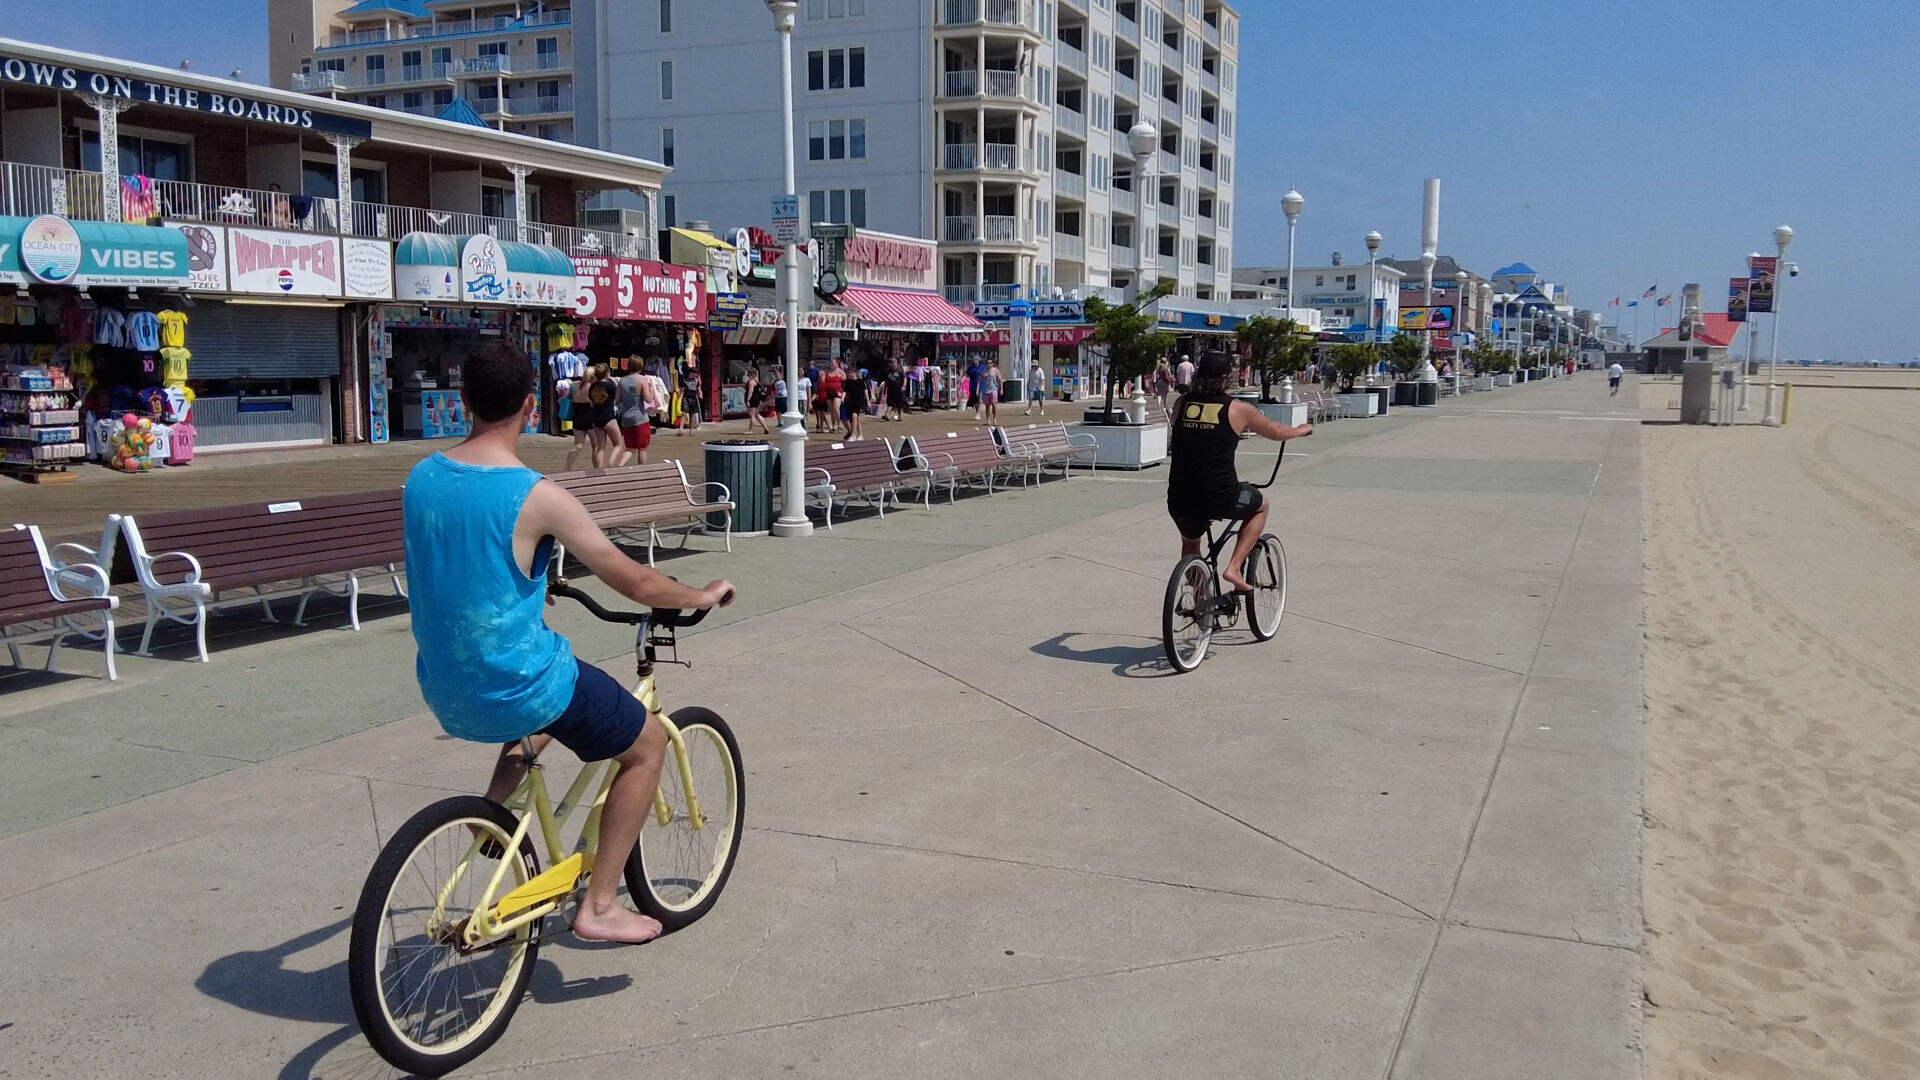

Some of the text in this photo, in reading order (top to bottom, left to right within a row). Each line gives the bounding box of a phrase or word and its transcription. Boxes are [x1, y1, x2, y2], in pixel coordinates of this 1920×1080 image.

[0, 59, 313, 128] OWS ON THE BOARDS
[24, 240, 79, 252] OCEAN CITY
[200, 228, 215, 255] INSIDE
[91, 248, 177, 270] VIBES
[234, 230, 336, 282] WRAPPER
[844, 236, 932, 271] SASSY BEACHWEAR
[576, 266, 601, 276] OVER
[643, 275, 681, 296] NOTHING
[648, 297, 672, 315] OVER
[142, 325, 151, 338] 10
[939, 330, 992, 343] CANDY
[999, 330, 1074, 342] KCHEN
[143, 360, 154, 372] 10
[173, 359, 182, 372] 10
[152, 399, 162, 413] 19
[175, 399, 185, 412] 7
[101, 430, 108, 443] 8
[178, 434, 189, 446] 10
